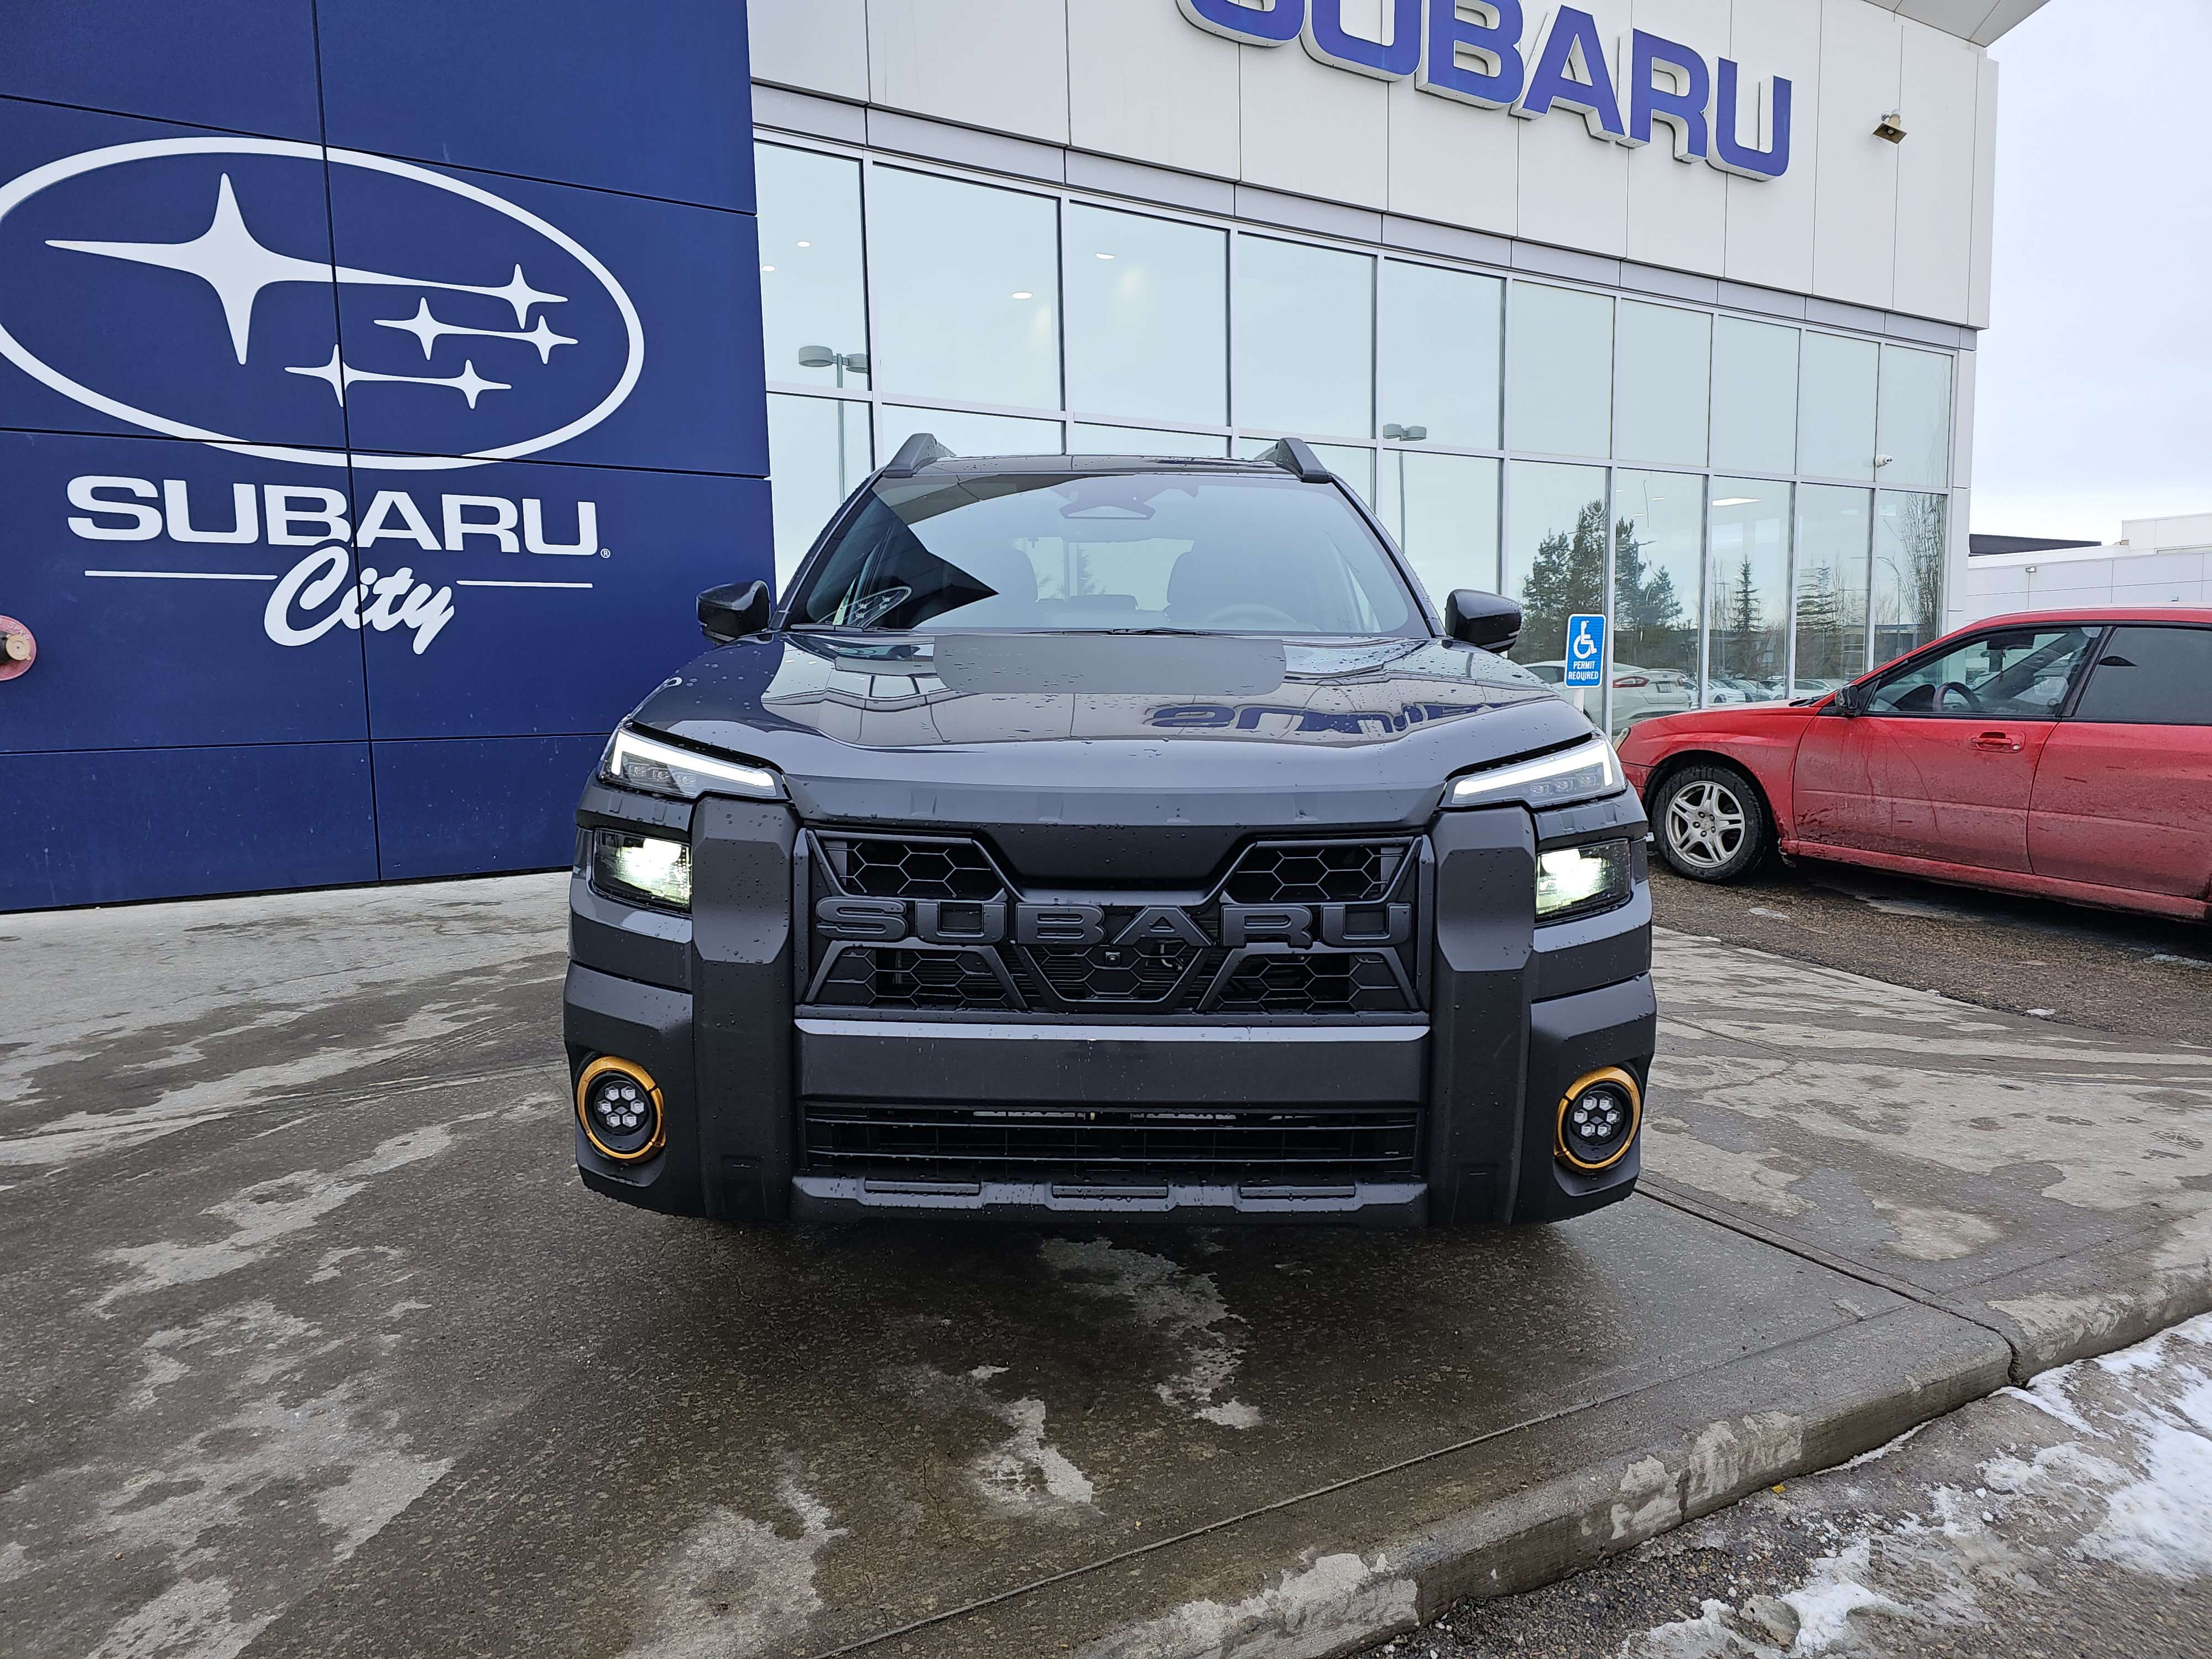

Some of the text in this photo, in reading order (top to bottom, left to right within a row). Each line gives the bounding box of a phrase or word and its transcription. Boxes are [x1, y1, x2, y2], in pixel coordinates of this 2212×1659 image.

[264, 545, 455, 655] City
[1568, 671, 1599, 681] REQUIRED
[1573, 661, 1595, 669] PERMIT
[815, 895, 1412, 946] SUBARU
